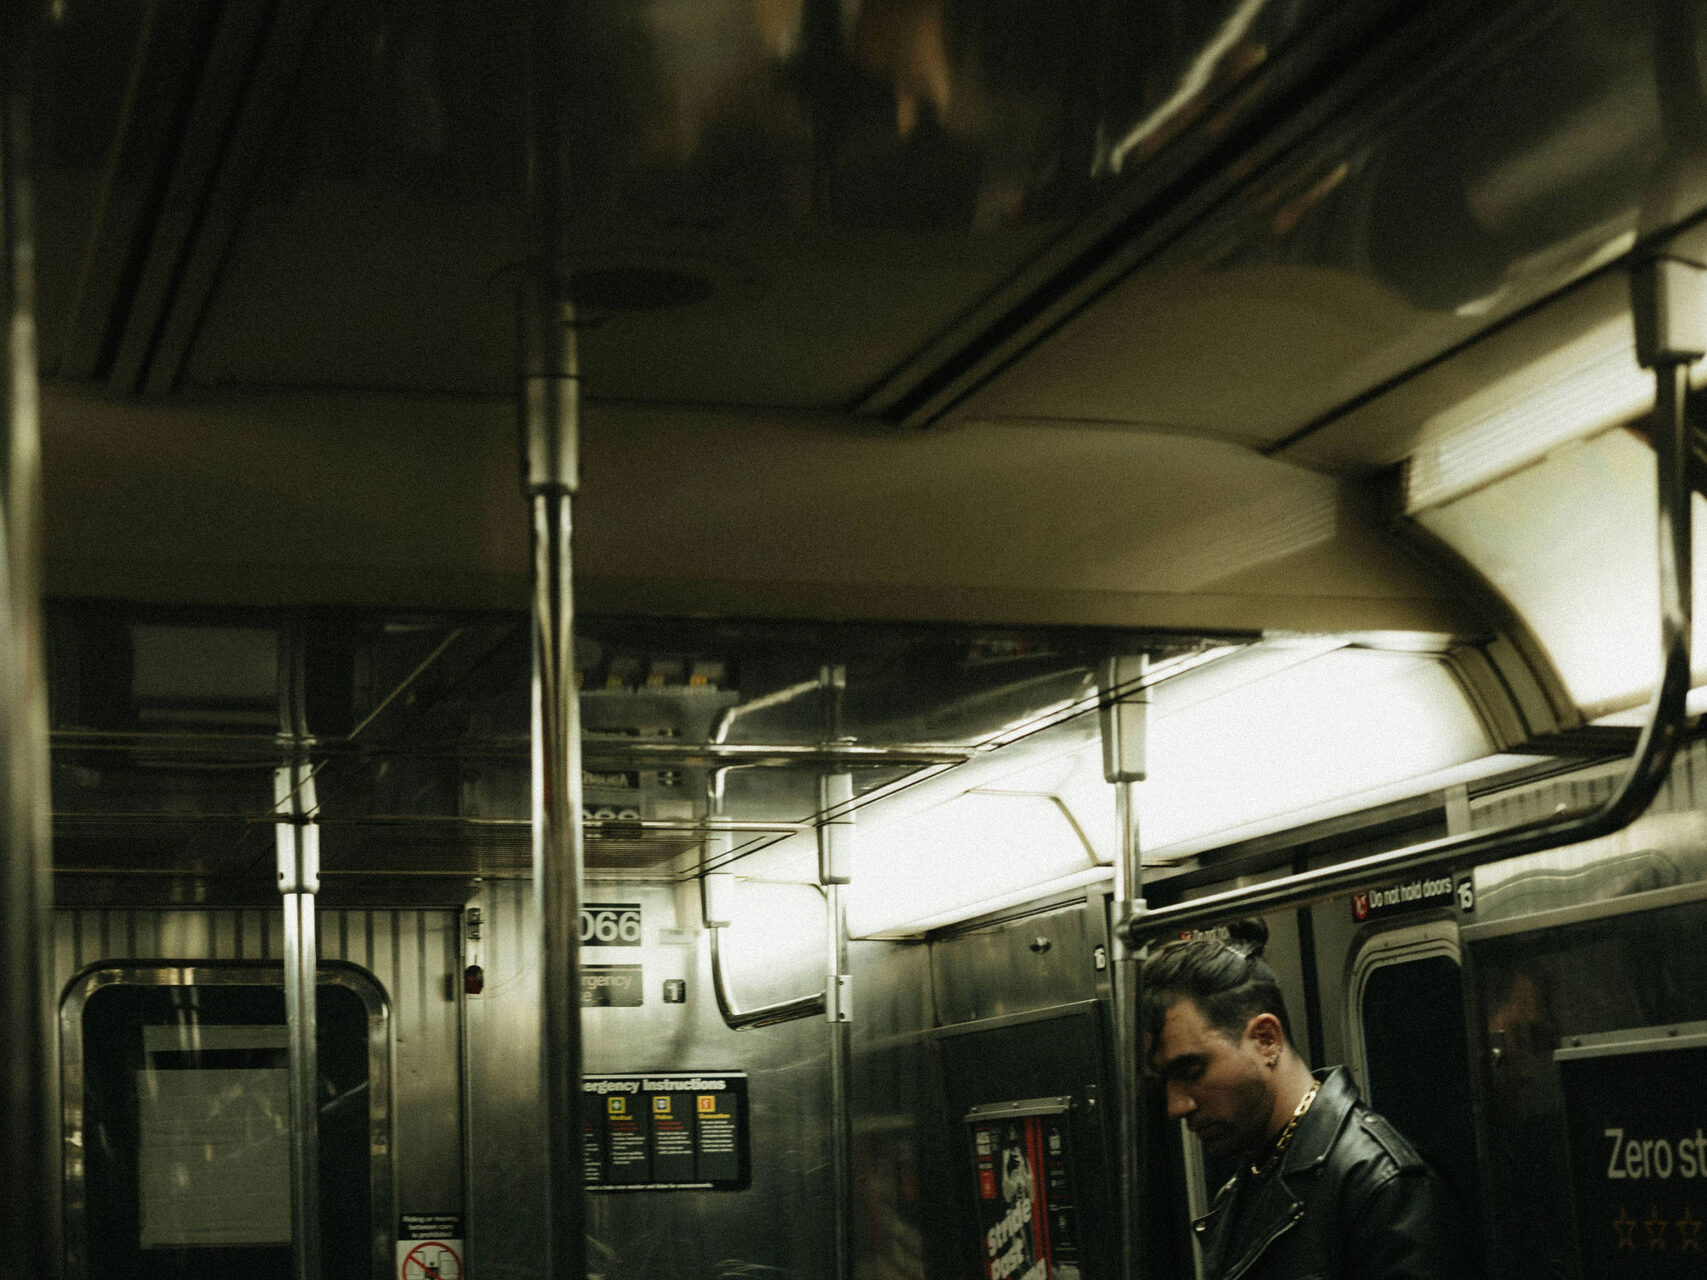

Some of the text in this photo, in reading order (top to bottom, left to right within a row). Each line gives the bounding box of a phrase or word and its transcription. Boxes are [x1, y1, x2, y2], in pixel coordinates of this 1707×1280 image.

[1369, 876, 1452, 908] Do not hold doors
[1457, 881, 1473, 909] 15
[666, 982, 679, 1001] 1
[1604, 1128, 1673, 1180] Zero
